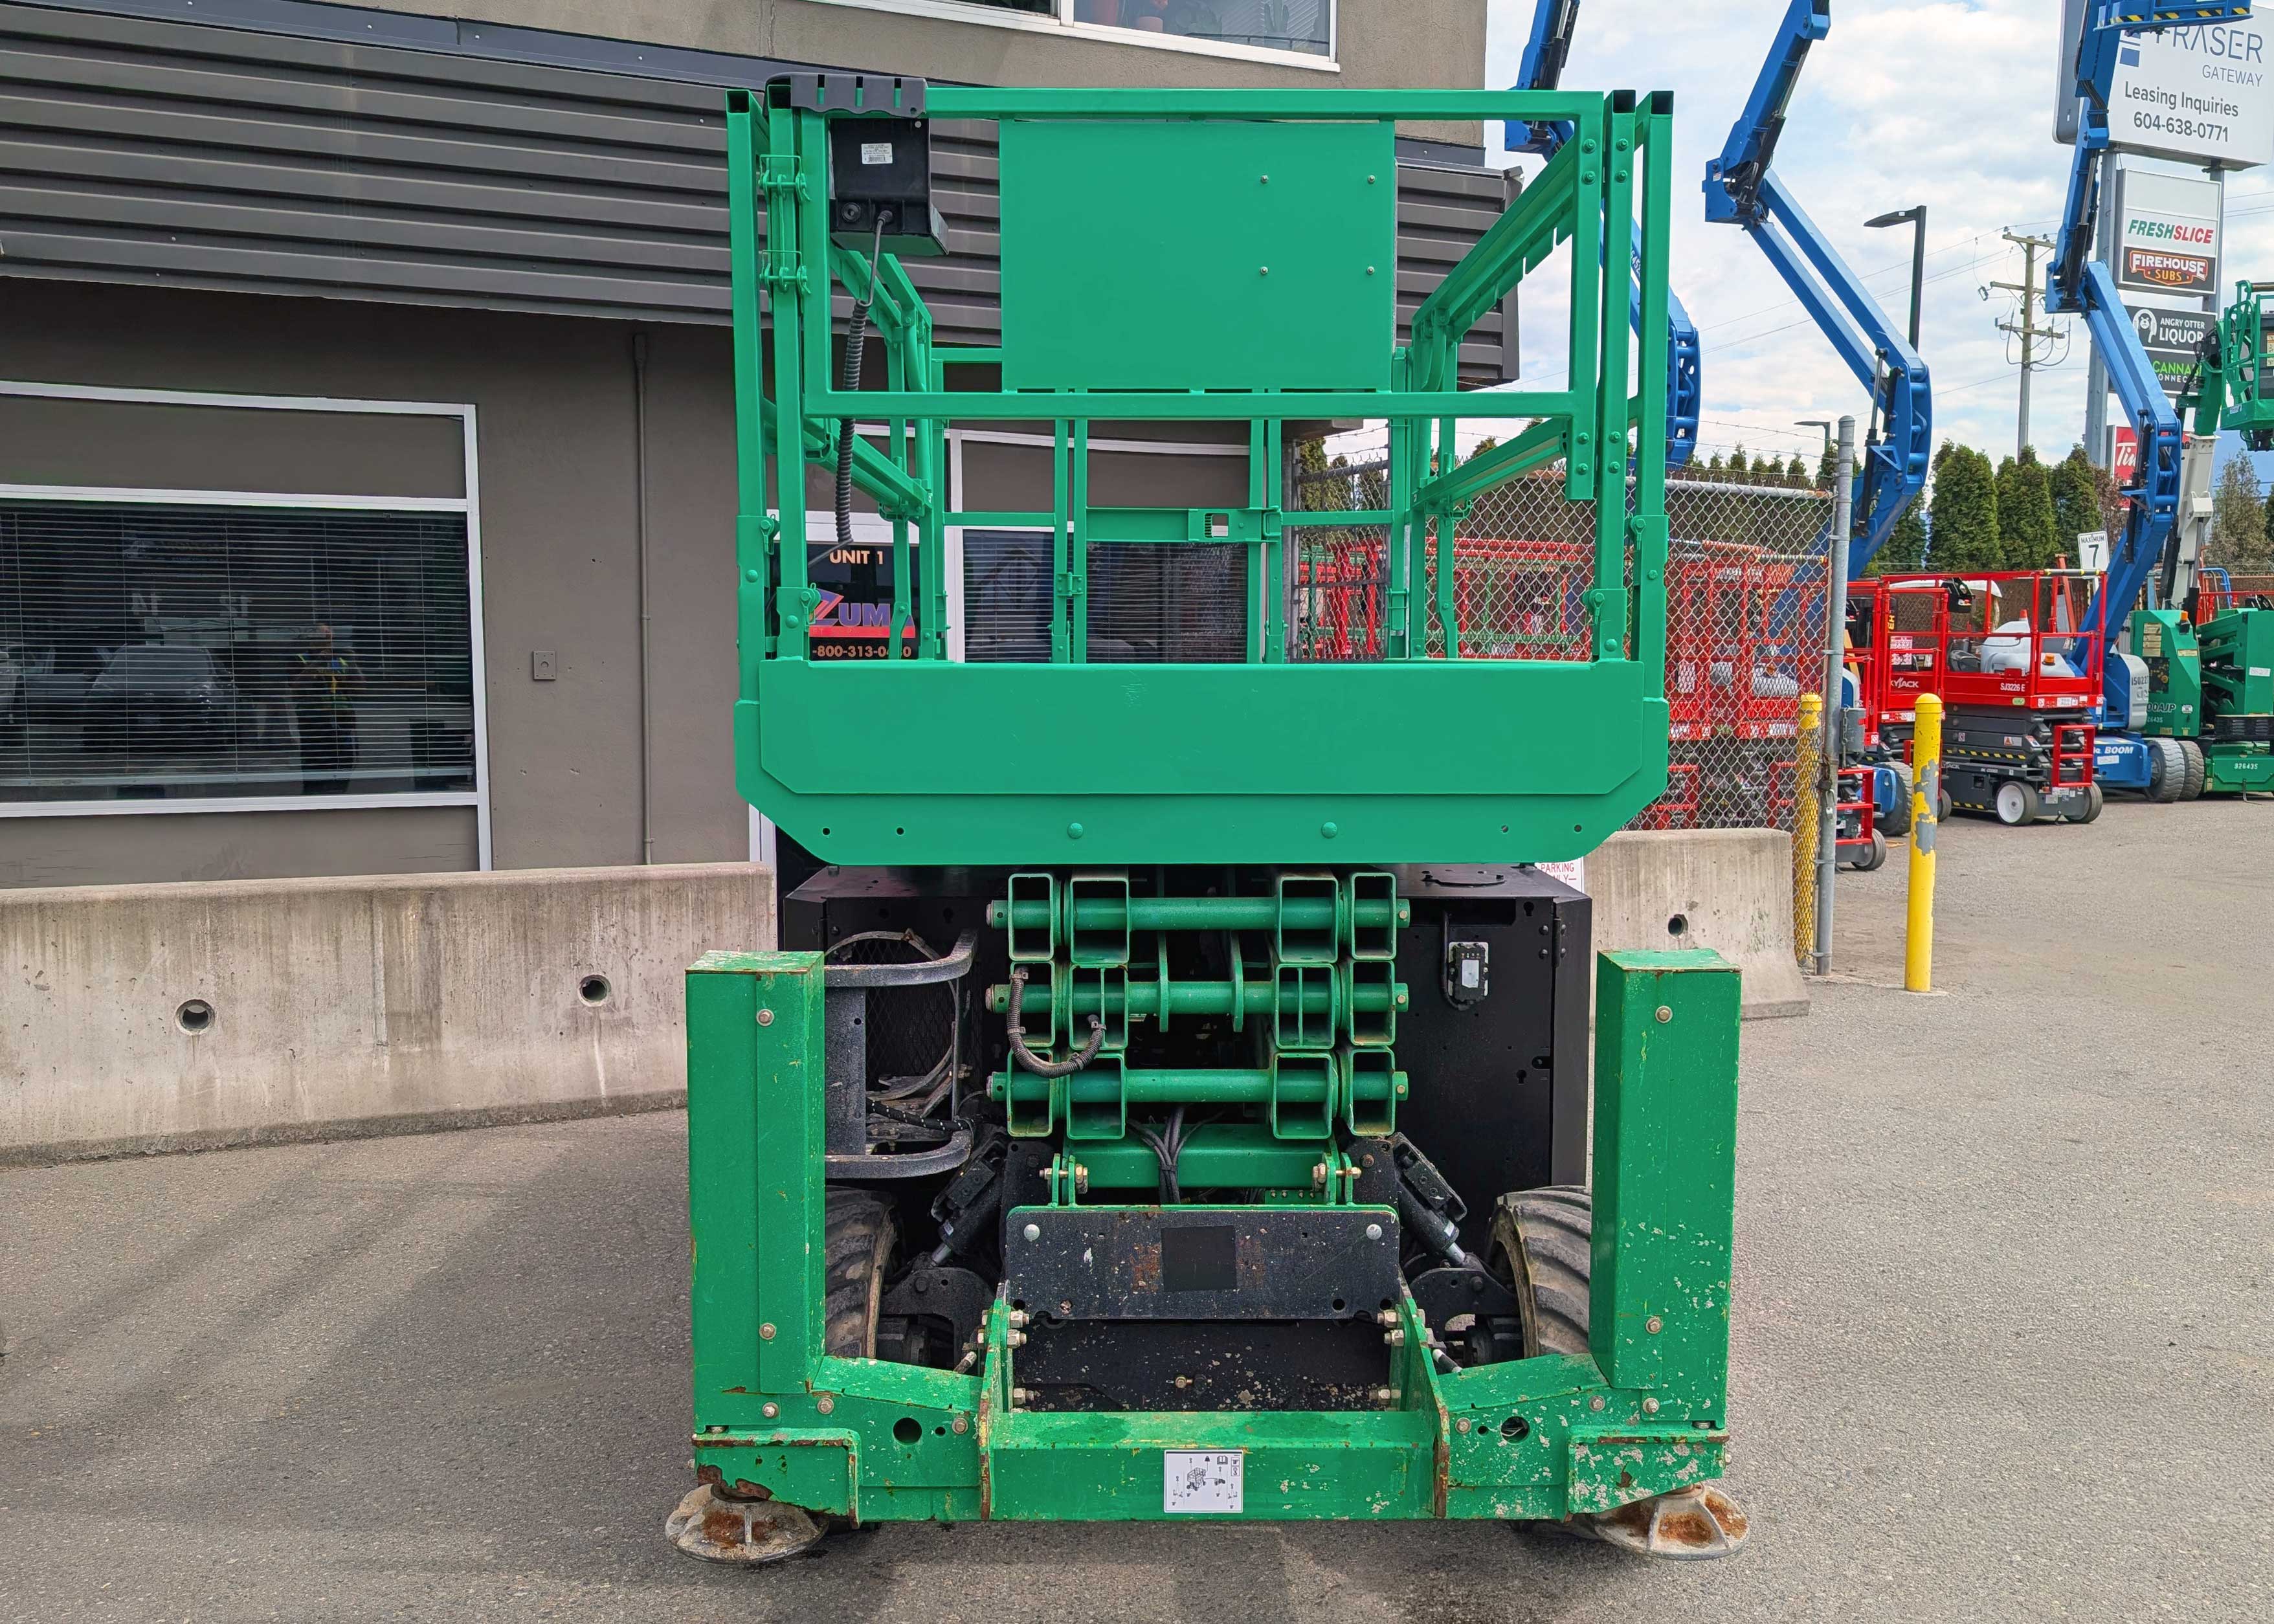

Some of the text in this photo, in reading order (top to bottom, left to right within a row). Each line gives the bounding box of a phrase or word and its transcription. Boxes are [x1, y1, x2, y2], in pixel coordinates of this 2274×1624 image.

[2202, 64, 2263, 87] GATEWAY
[2124, 81, 2238, 117] Leasing Inquiries
[2134, 111, 2229, 142] 604-638-0771
[2128, 219, 2214, 244] FRESHSLICE
[2131, 253, 2206, 281] FIREHOUSE
[2155, 269, 2182, 281] SUBS
[2160, 317, 2205, 329] ANGRY OTTER
[2159, 328, 2204, 345] LIQUOR
[2080, 535, 2104, 544] MAXIMUM
[829, 550, 884, 564] UNIT 1
[2088, 544, 2099, 568] 7
[814, 588, 915, 627] ZUM
[2021, 684, 2025, 692] E
[1541, 862, 1574, 873] PARKING
